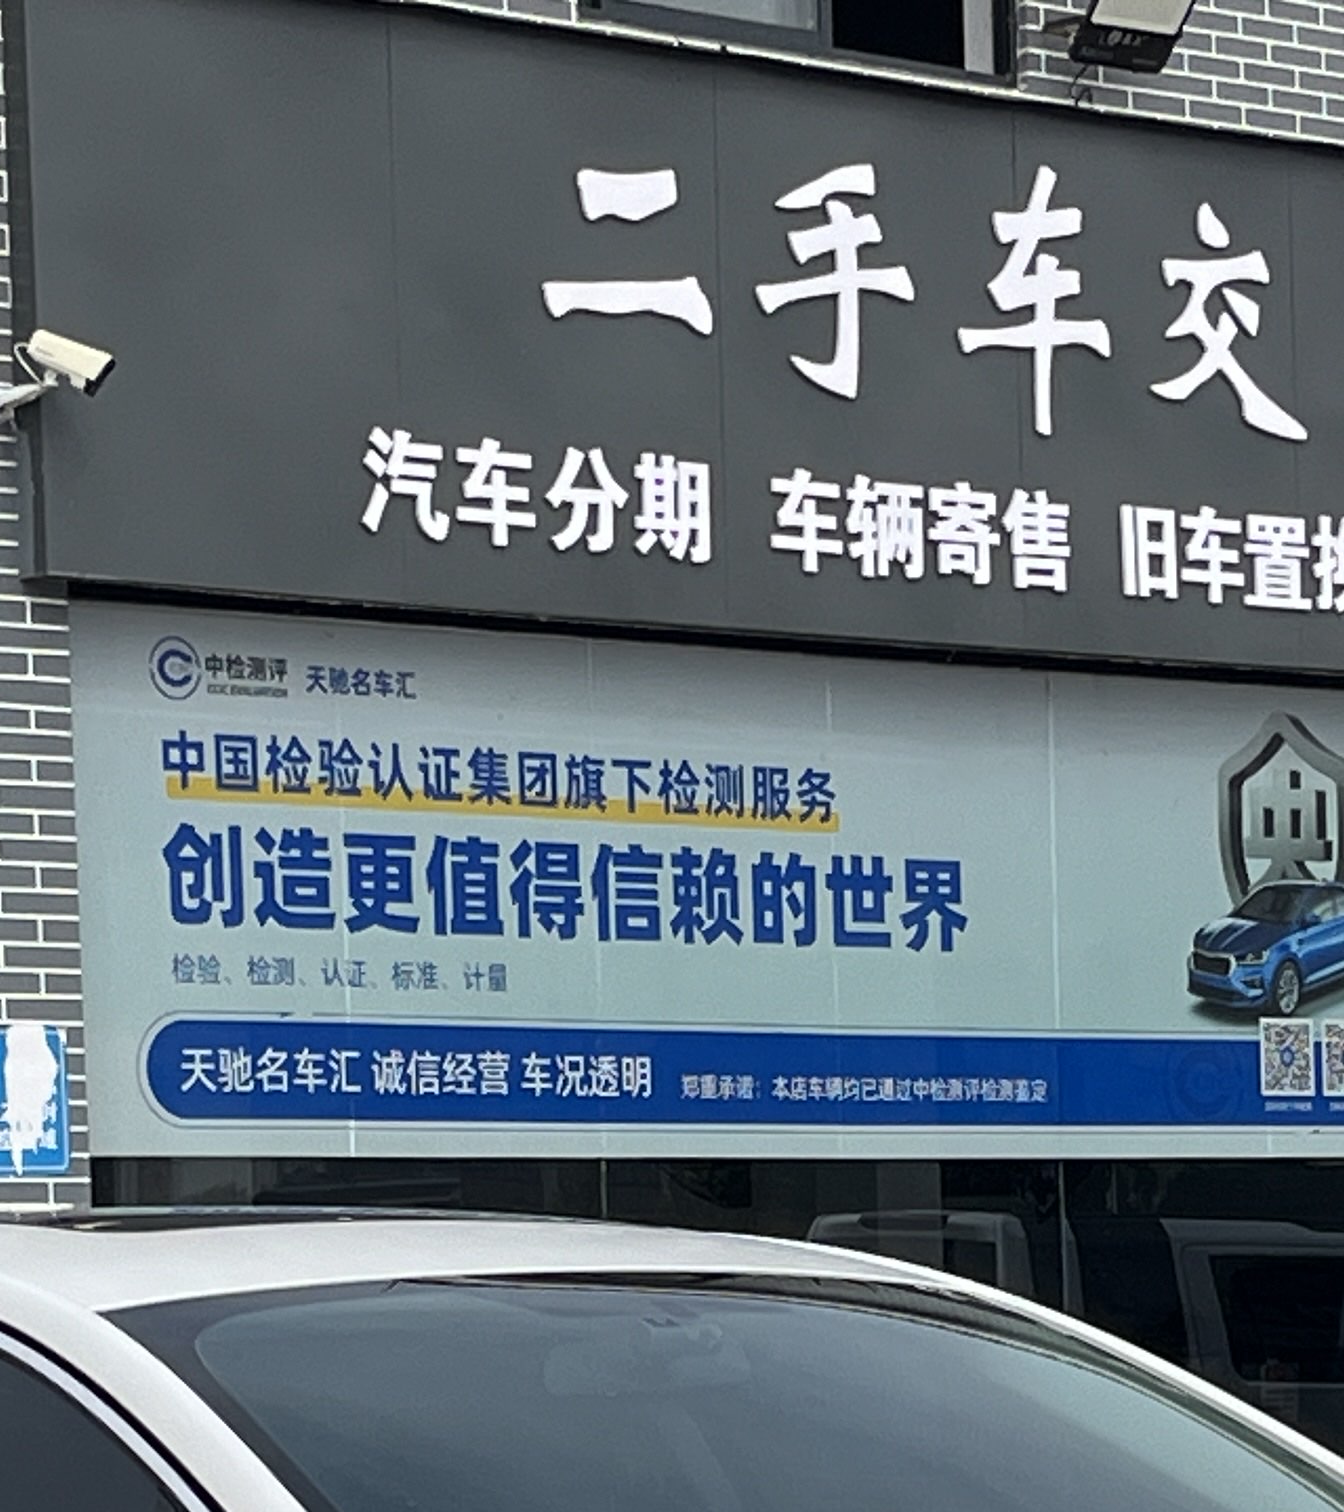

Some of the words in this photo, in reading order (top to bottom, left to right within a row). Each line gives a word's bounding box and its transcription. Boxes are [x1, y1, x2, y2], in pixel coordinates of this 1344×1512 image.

[360, 426, 714, 564] 汽车分期
[769, 467, 1072, 593] 车辆寄售
[205, 653, 288, 682] 中检测评
[306, 665, 416, 700] 天驰名车汇
[161, 730, 837, 824] 中国检验认证集团旗下检测服务
[161, 822, 968, 952] 创造更值得信赖的世界
[180, 1047, 362, 1095] 天驰名车汇
[371, 1049, 511, 1096] 诚信经营
[521, 1052, 652, 1099] 车况透明
